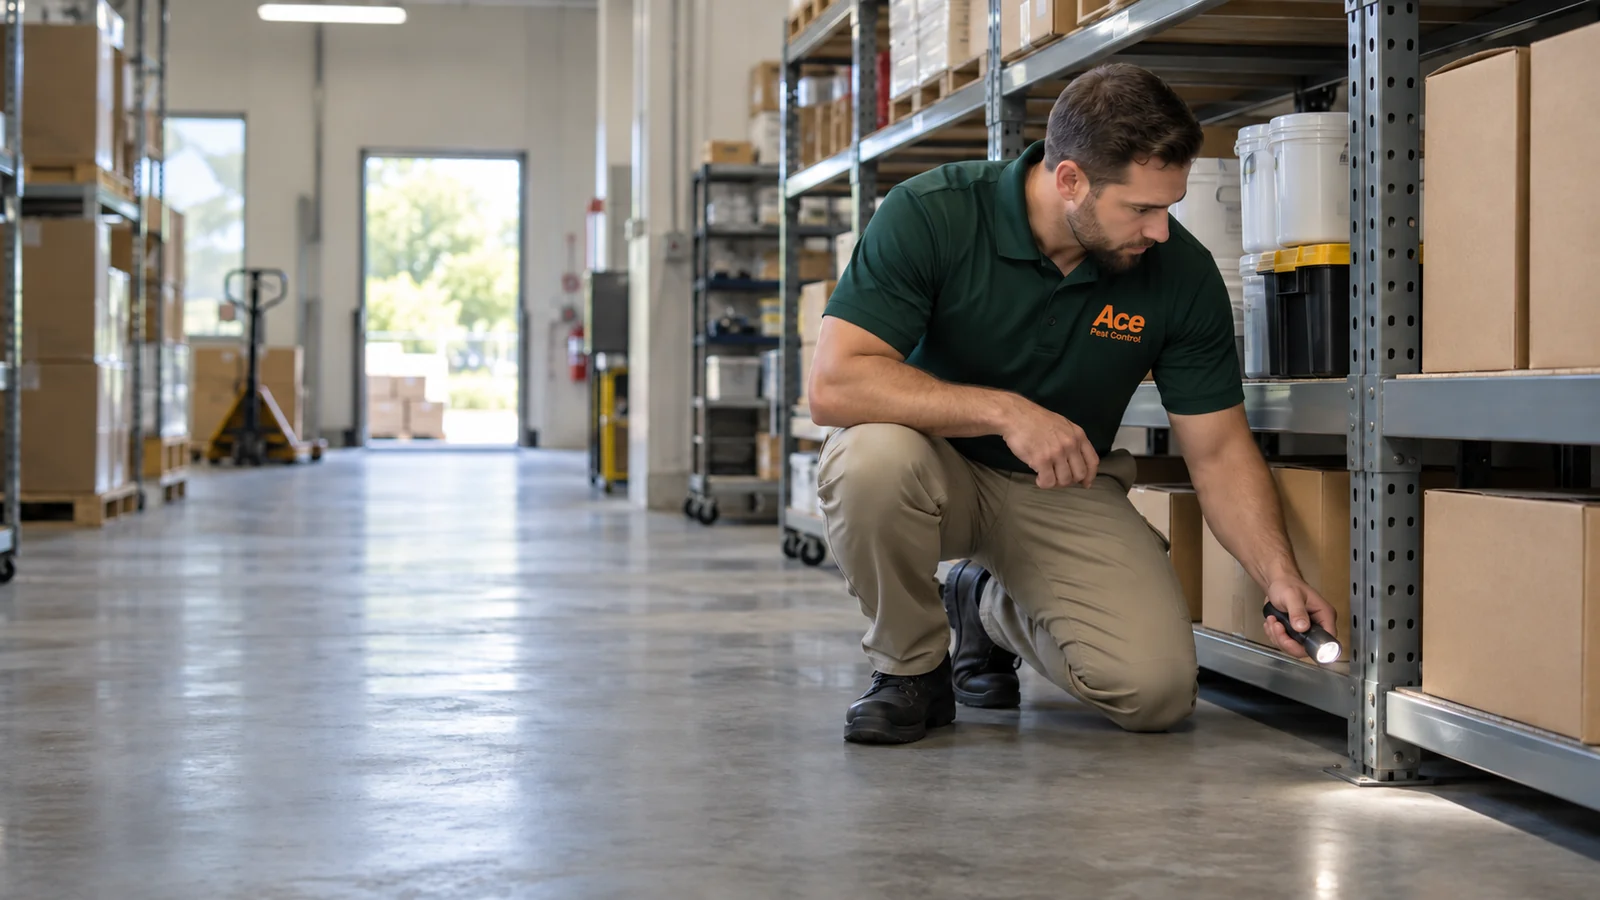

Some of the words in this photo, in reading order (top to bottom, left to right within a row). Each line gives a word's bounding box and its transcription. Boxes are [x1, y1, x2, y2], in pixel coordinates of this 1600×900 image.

[1092, 304, 1145, 333] Ace
[1090, 327, 1109, 338] Pest
[1110, 331, 1142, 343] Control
